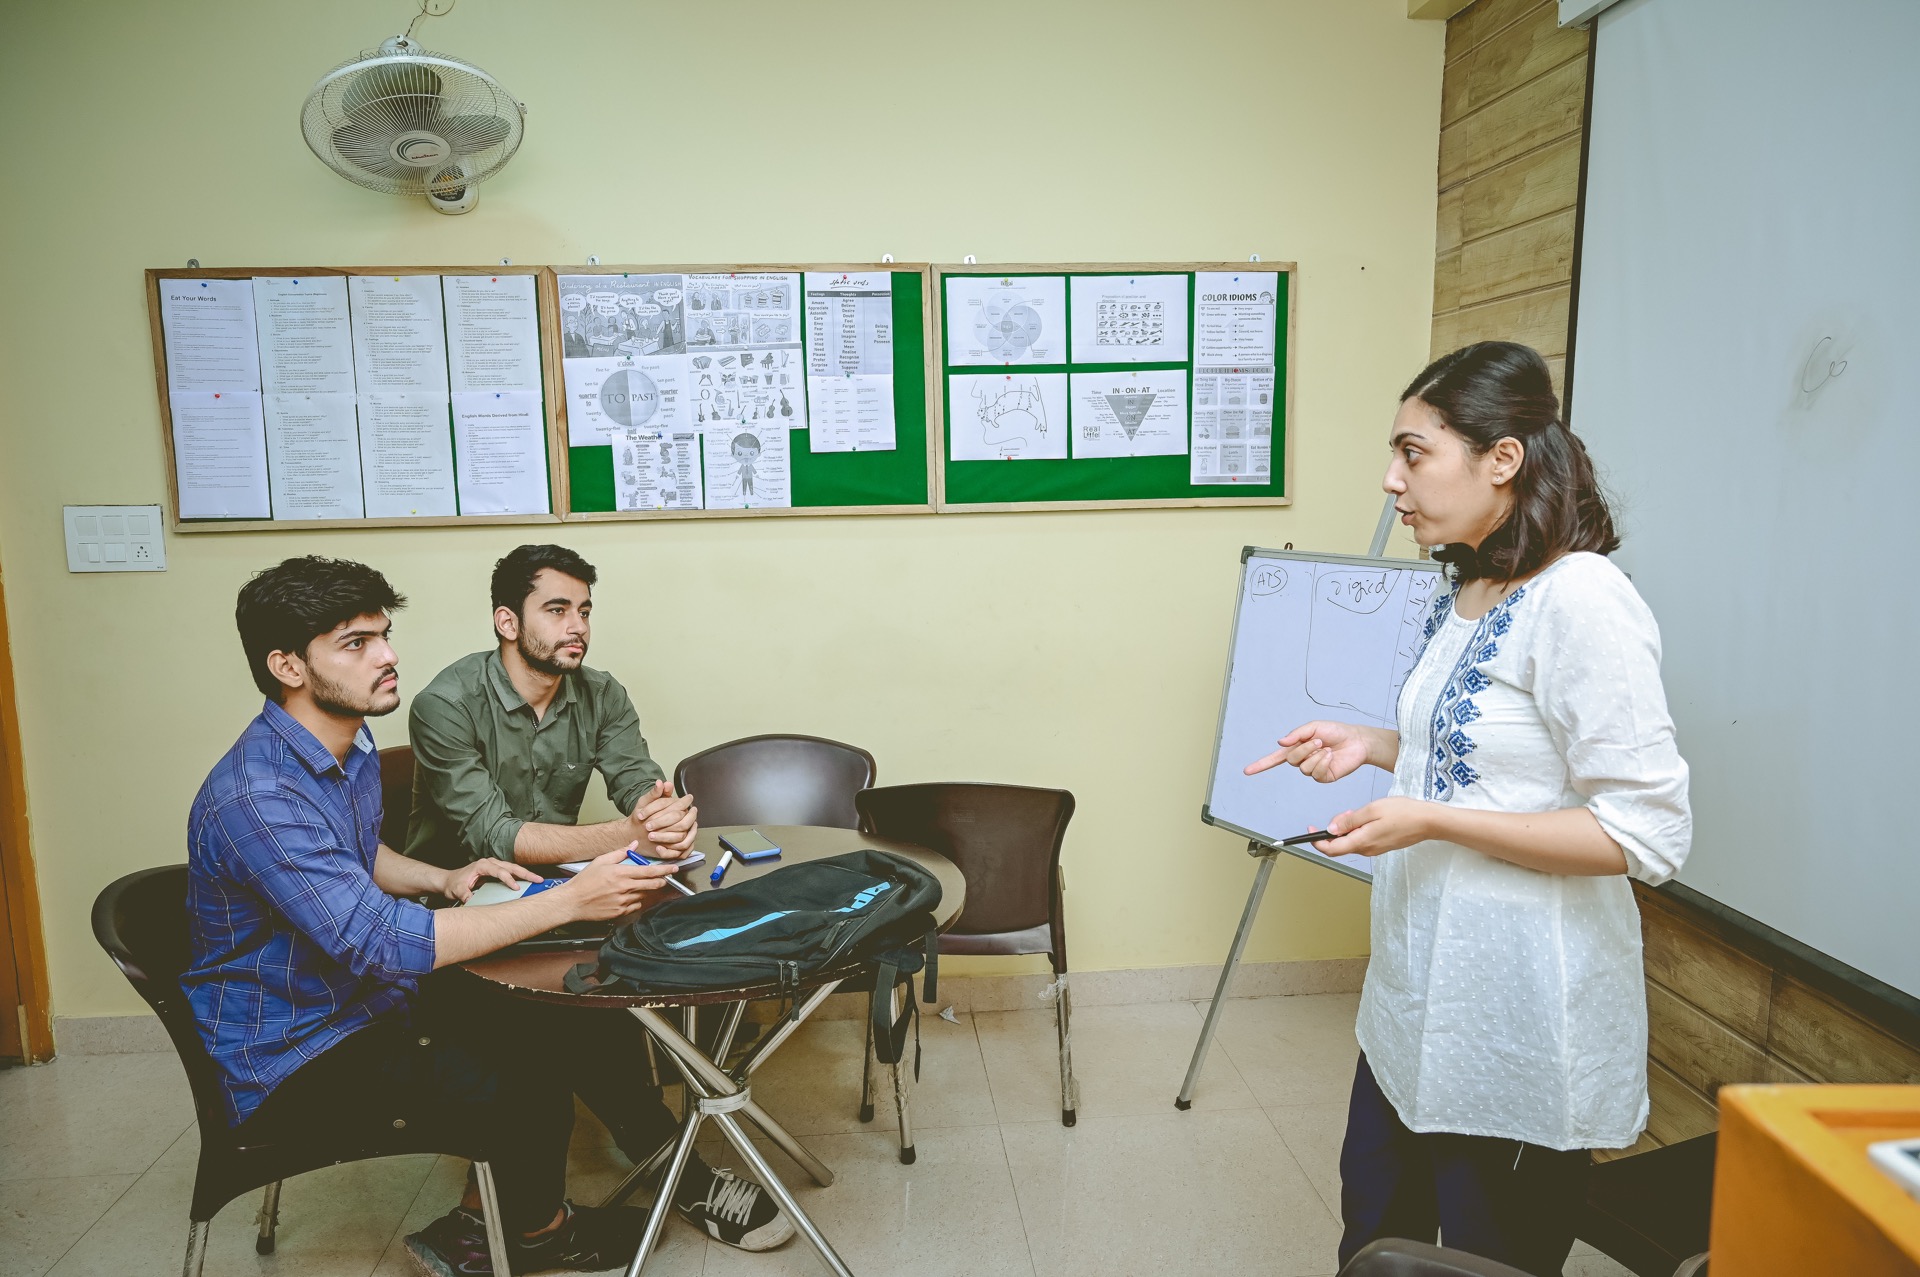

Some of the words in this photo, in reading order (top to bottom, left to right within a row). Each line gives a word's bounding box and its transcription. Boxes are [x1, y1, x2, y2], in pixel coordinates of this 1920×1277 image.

[561, 282, 592, 293] Ordering
[610, 280, 649, 288] Restaurant
[604, 394, 625, 404] TO
[632, 393, 656, 401] PAST
